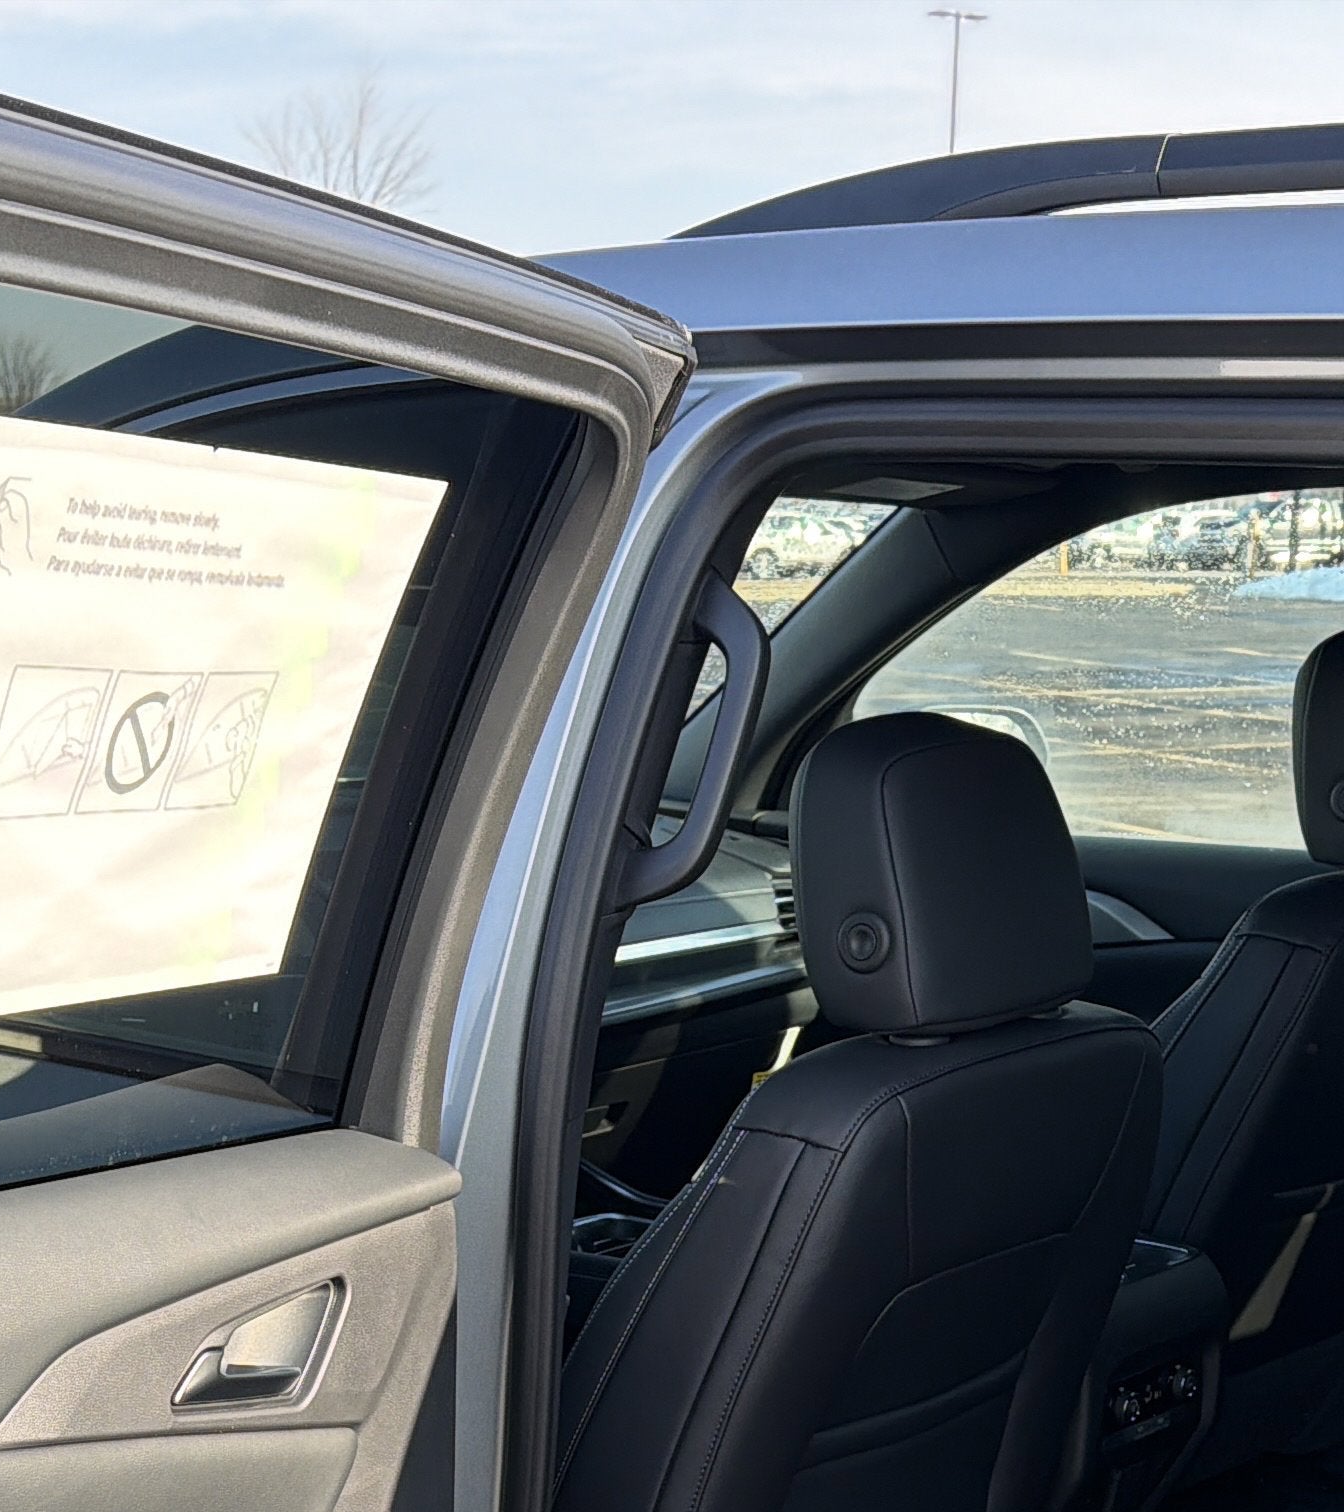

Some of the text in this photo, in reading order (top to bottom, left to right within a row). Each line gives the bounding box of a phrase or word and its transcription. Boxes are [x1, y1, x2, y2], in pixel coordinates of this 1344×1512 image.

[67, 497, 78, 514] To
[79, 499, 101, 519] help
[102, 503, 127, 519] avoid
[160, 510, 191, 526] remove
[56, 526, 80, 543] Pour
[46, 555, 71, 572] Para
[71, 559, 114, 577] ayudarse
[115, 565, 122, 578] a
[123, 563, 148, 579] evitar
[148, 567, 165, 583] que
[165, 568, 176, 581] se
